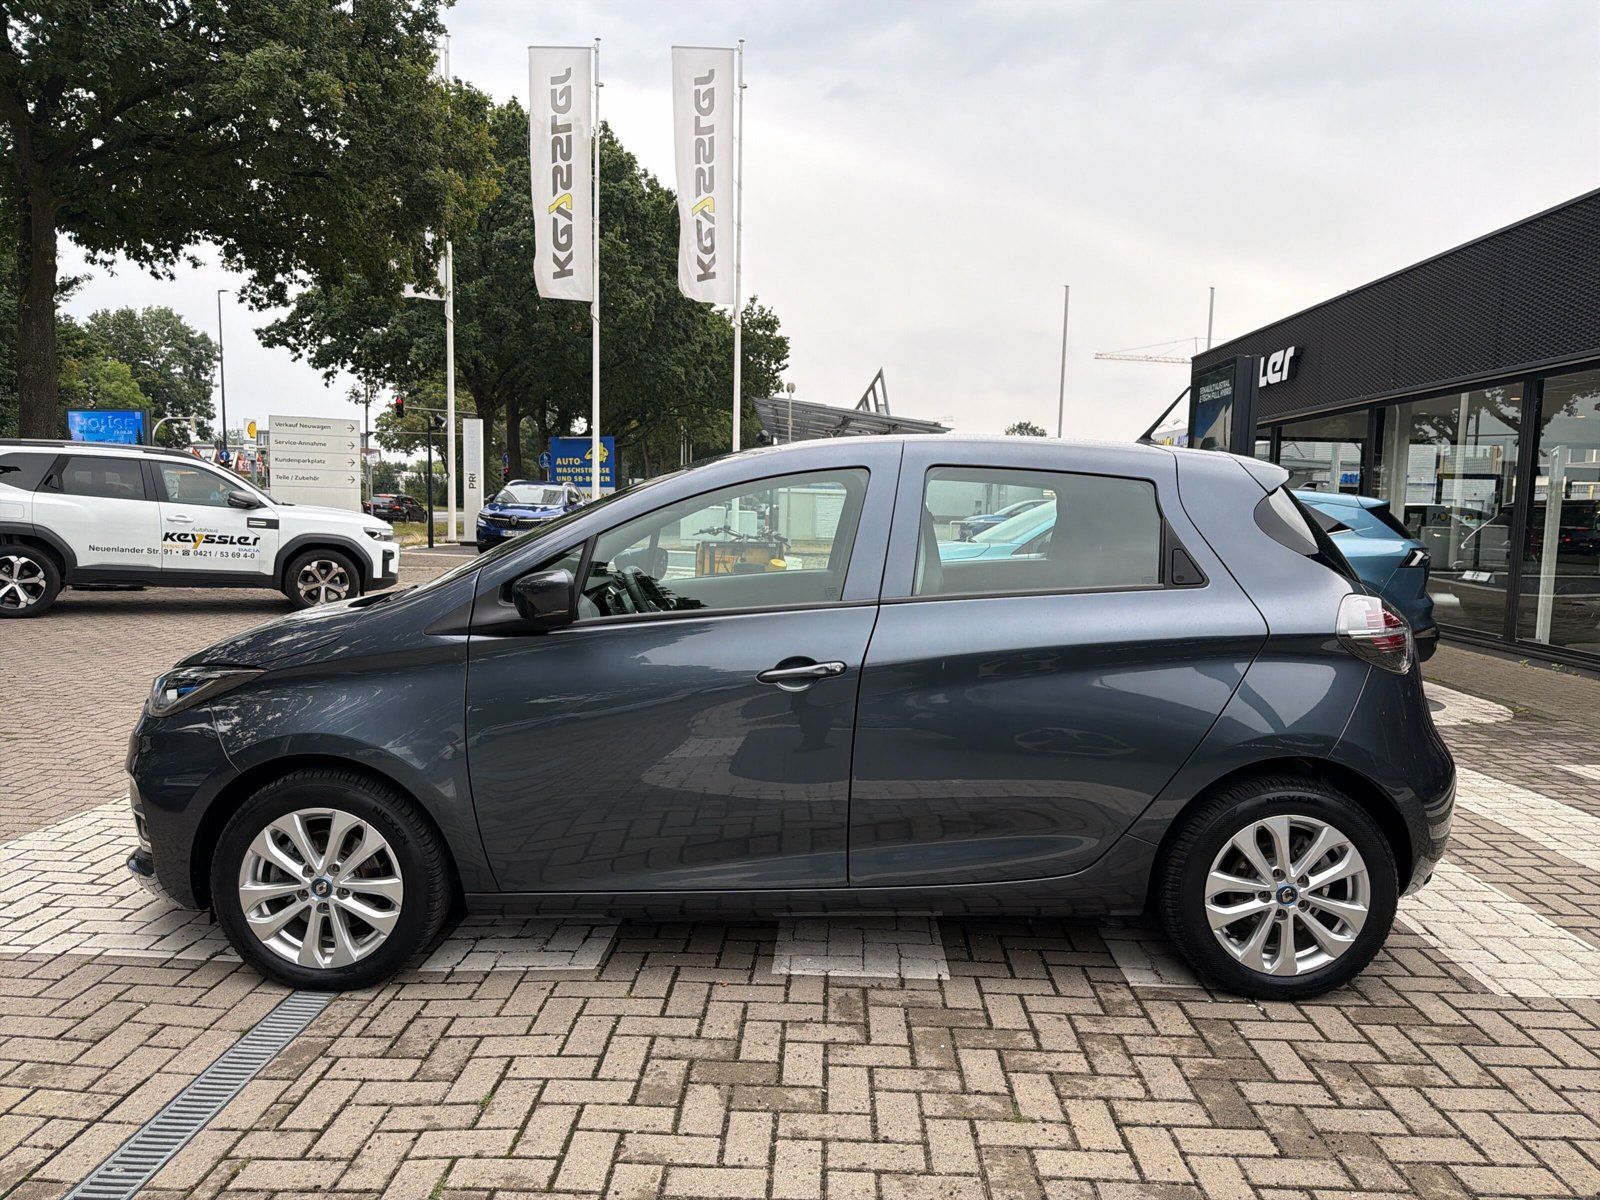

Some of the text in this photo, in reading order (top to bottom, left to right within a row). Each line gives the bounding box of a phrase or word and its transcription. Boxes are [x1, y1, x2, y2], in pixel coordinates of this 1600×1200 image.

[556, 457, 583, 465] AUTO-
[88, 544, 145, 554] Neuenlander
[147, 547, 161, 555] Str.
[163, 548, 173, 556] 91
[231, 551, 241, 559] 69
[242, 552, 255, 560] 4-0
[1266, 795, 1320, 805] NEXEN
[371, 805, 410, 846] NEXEN
